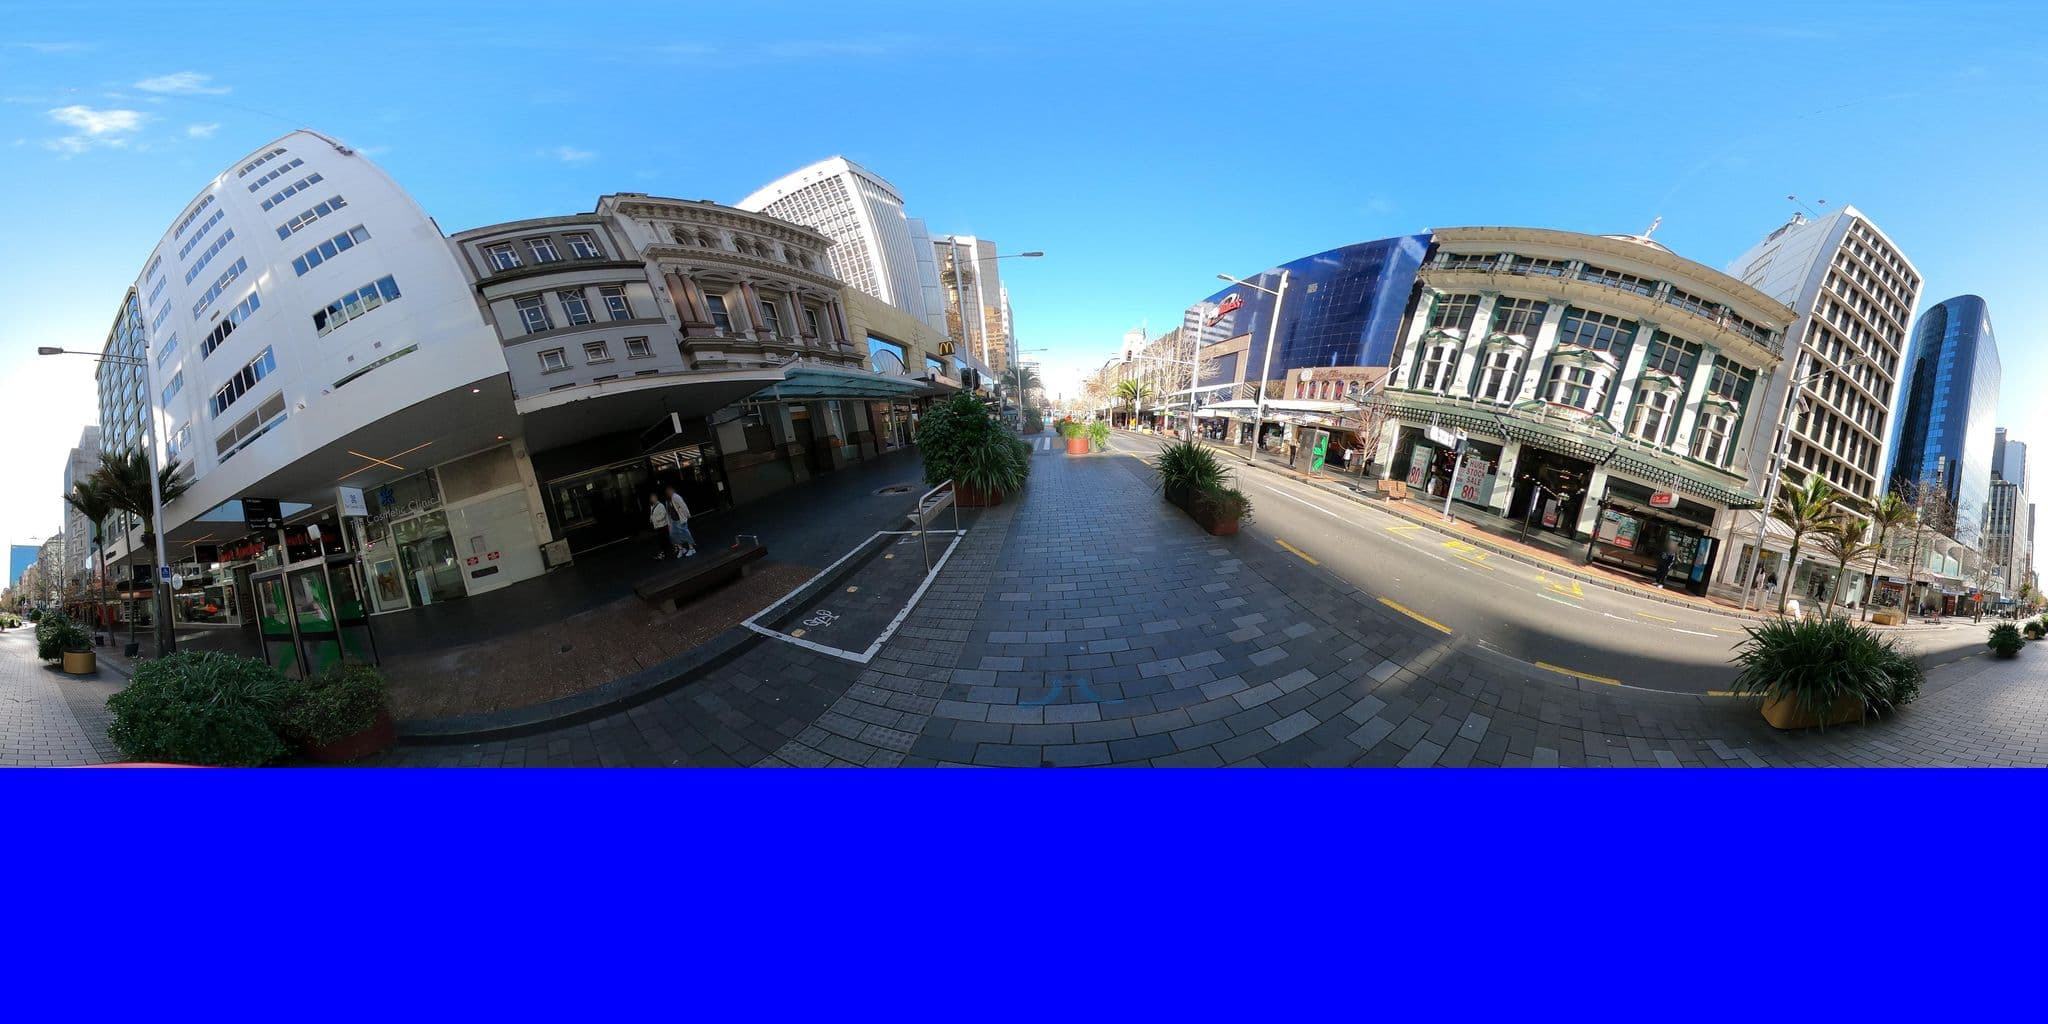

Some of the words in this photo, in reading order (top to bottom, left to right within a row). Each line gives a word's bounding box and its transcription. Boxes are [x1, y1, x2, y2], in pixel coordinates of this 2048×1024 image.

[1467, 467, 1485, 477] STOCK
[1467, 477, 1481, 486] SALE
[366, 507, 405, 524] Cosmetic
[408, 497, 435, 511] Clinic
